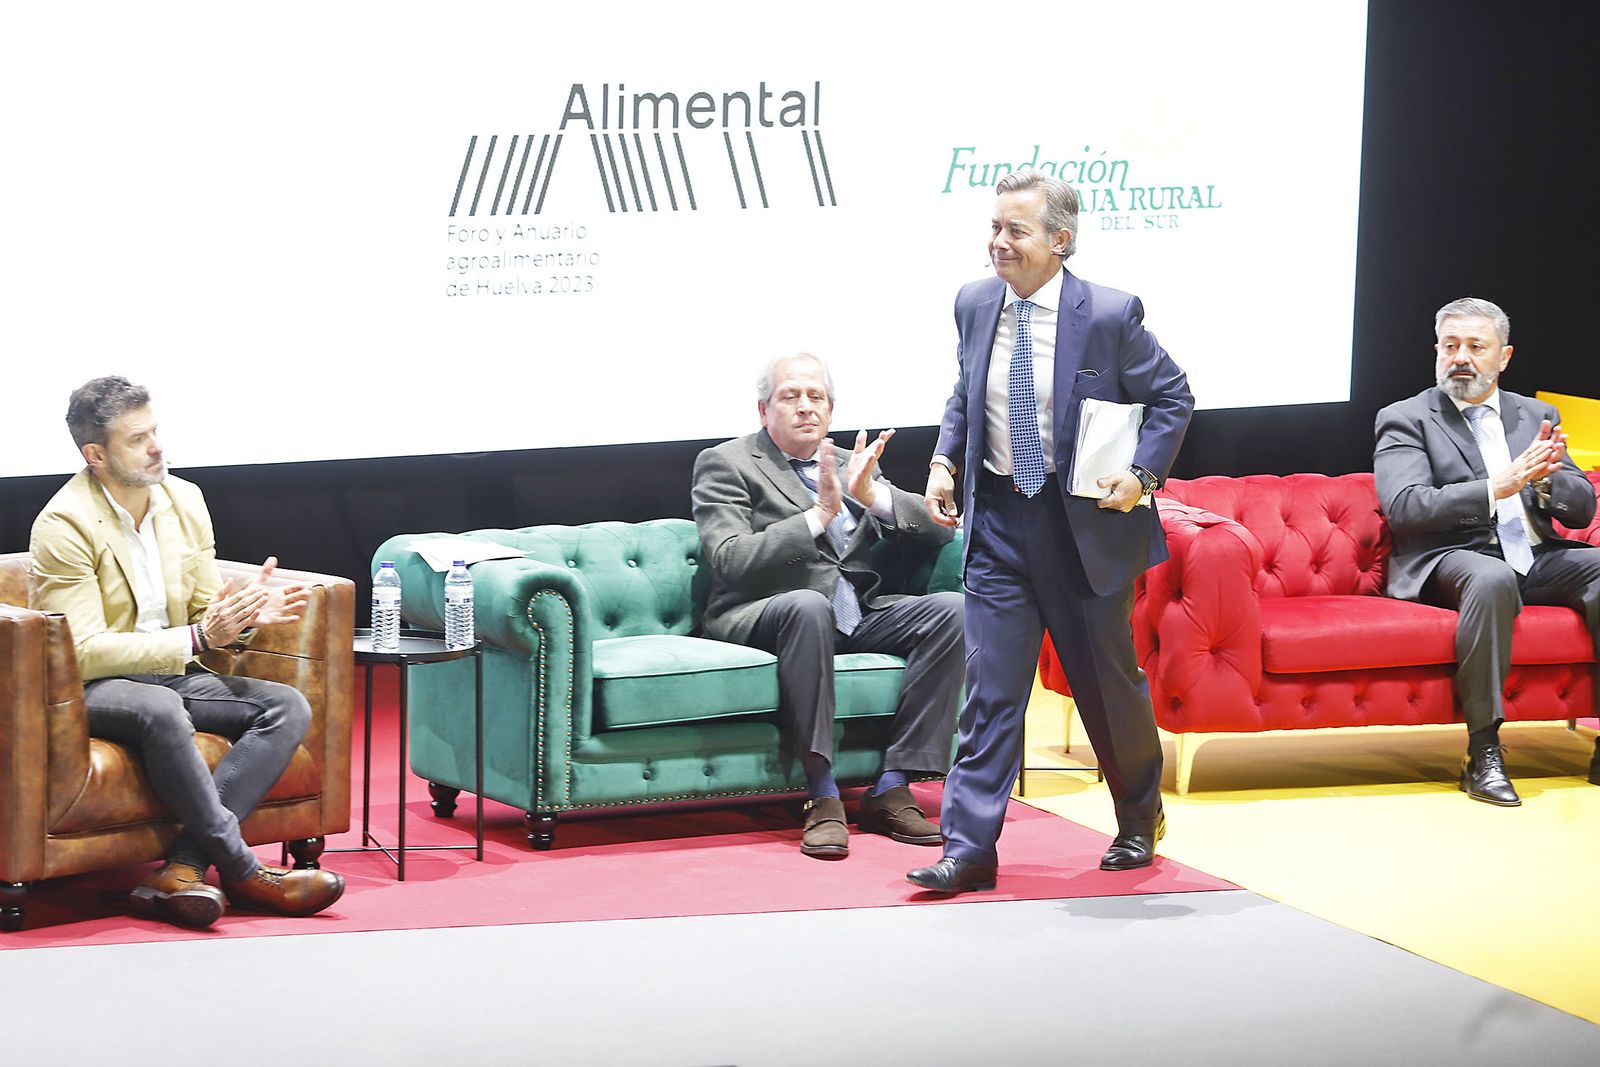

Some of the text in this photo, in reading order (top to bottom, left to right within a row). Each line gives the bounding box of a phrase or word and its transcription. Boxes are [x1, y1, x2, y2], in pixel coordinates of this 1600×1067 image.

[558, 81, 820, 131] Alimental
[1129, 185, 1222, 211] RURAL
[447, 222, 588, 246] Foro y Anuario
[1101, 214, 1179, 231] DEL SUR
[446, 250, 600, 276] agroalimentario
[445, 274, 594, 297] de Huelva 2023
